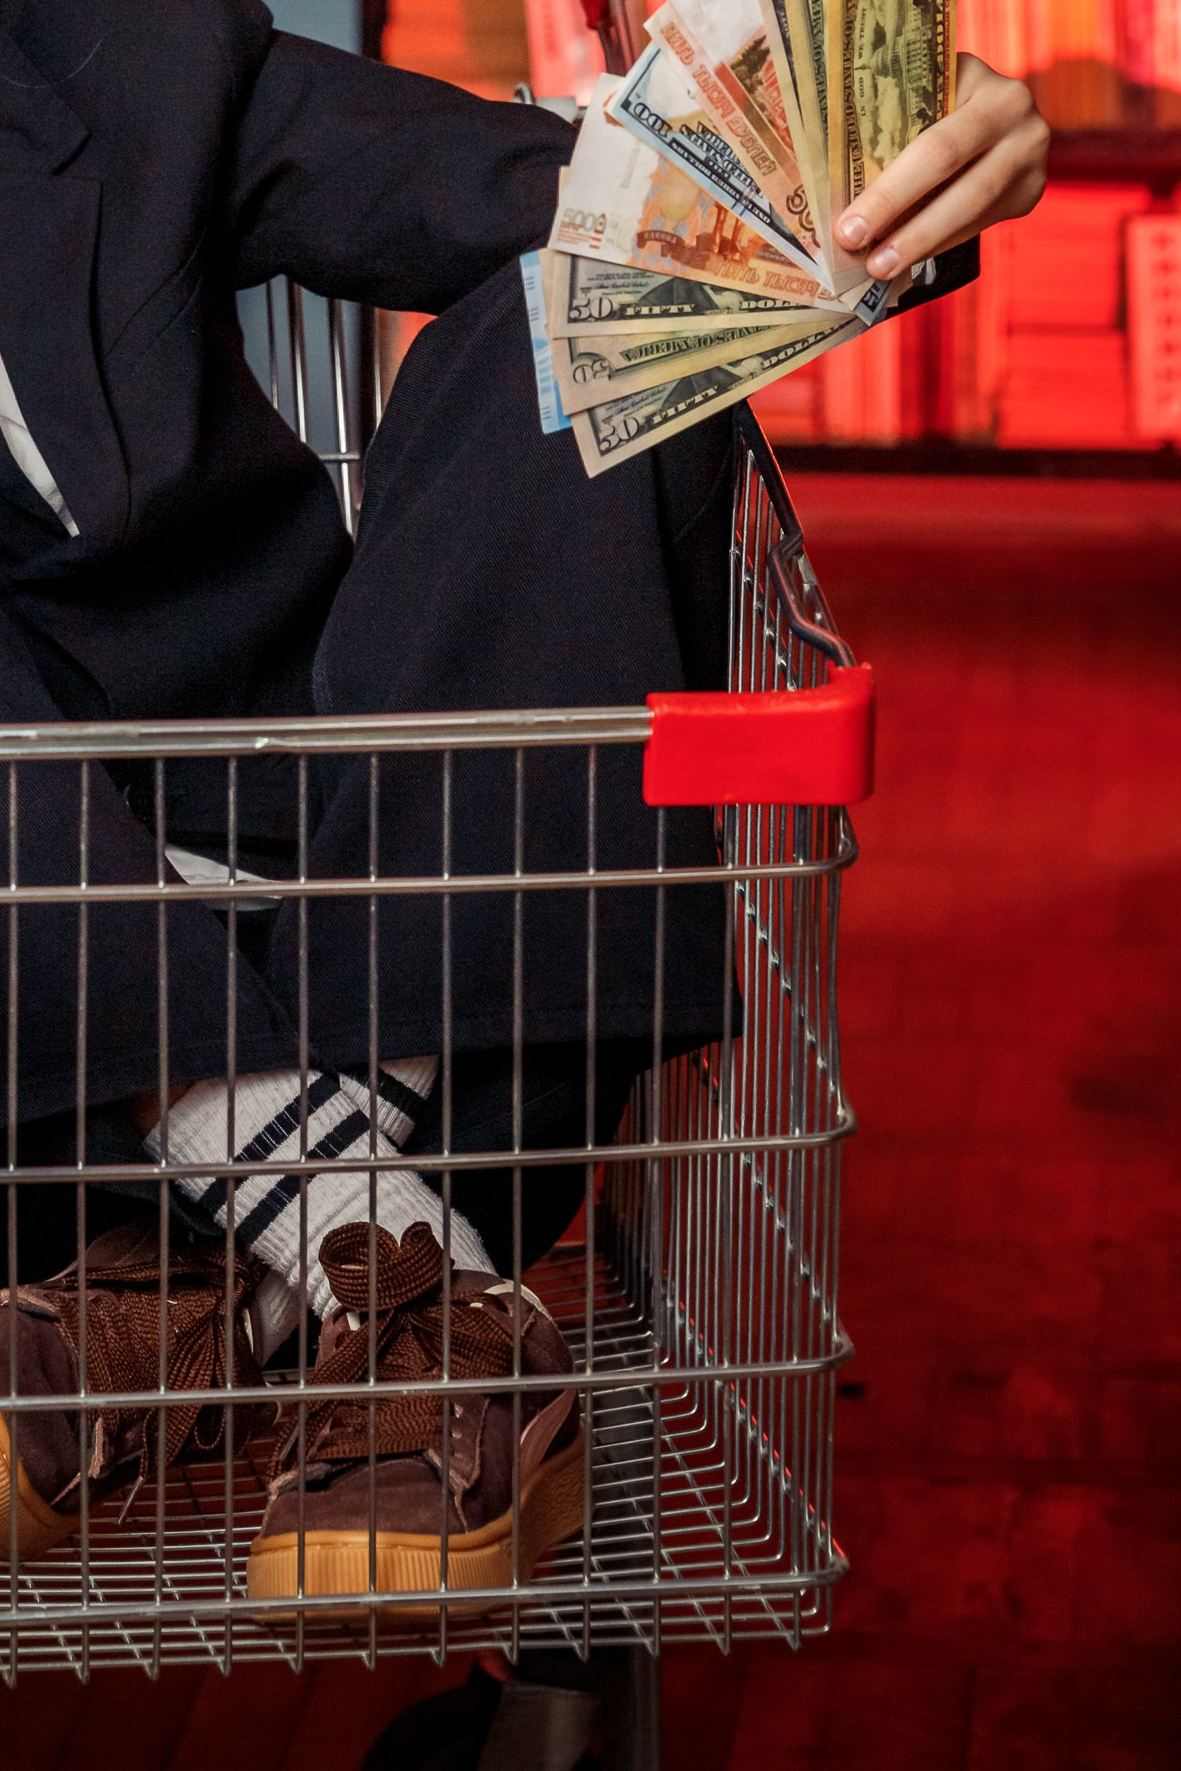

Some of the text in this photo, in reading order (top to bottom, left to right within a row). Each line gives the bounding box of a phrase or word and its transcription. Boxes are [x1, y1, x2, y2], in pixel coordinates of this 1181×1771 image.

[843, 15, 857, 37] OF
[858, 6, 868, 41] TRUST
[857, 44, 865, 60] WE
[843, 41, 856, 101] STATES
[659, 19, 780, 180] ПЯТЬ ТЫСЯЧ ДУБЛЕЙ
[860, 105, 867, 117] IN
[632, 101, 673, 139] 100
[845, 103, 863, 163] UNITED
[713, 261, 762, 285] ПЯТЬ
[765, 271, 820, 298] ТЫСЯЧ
[569, 296, 697, 321] 50 FIFTY
[619, 338, 696, 362] AMERICA
[599, 416, 639, 450] 50
[652, 385, 719, 425] FIFTY
